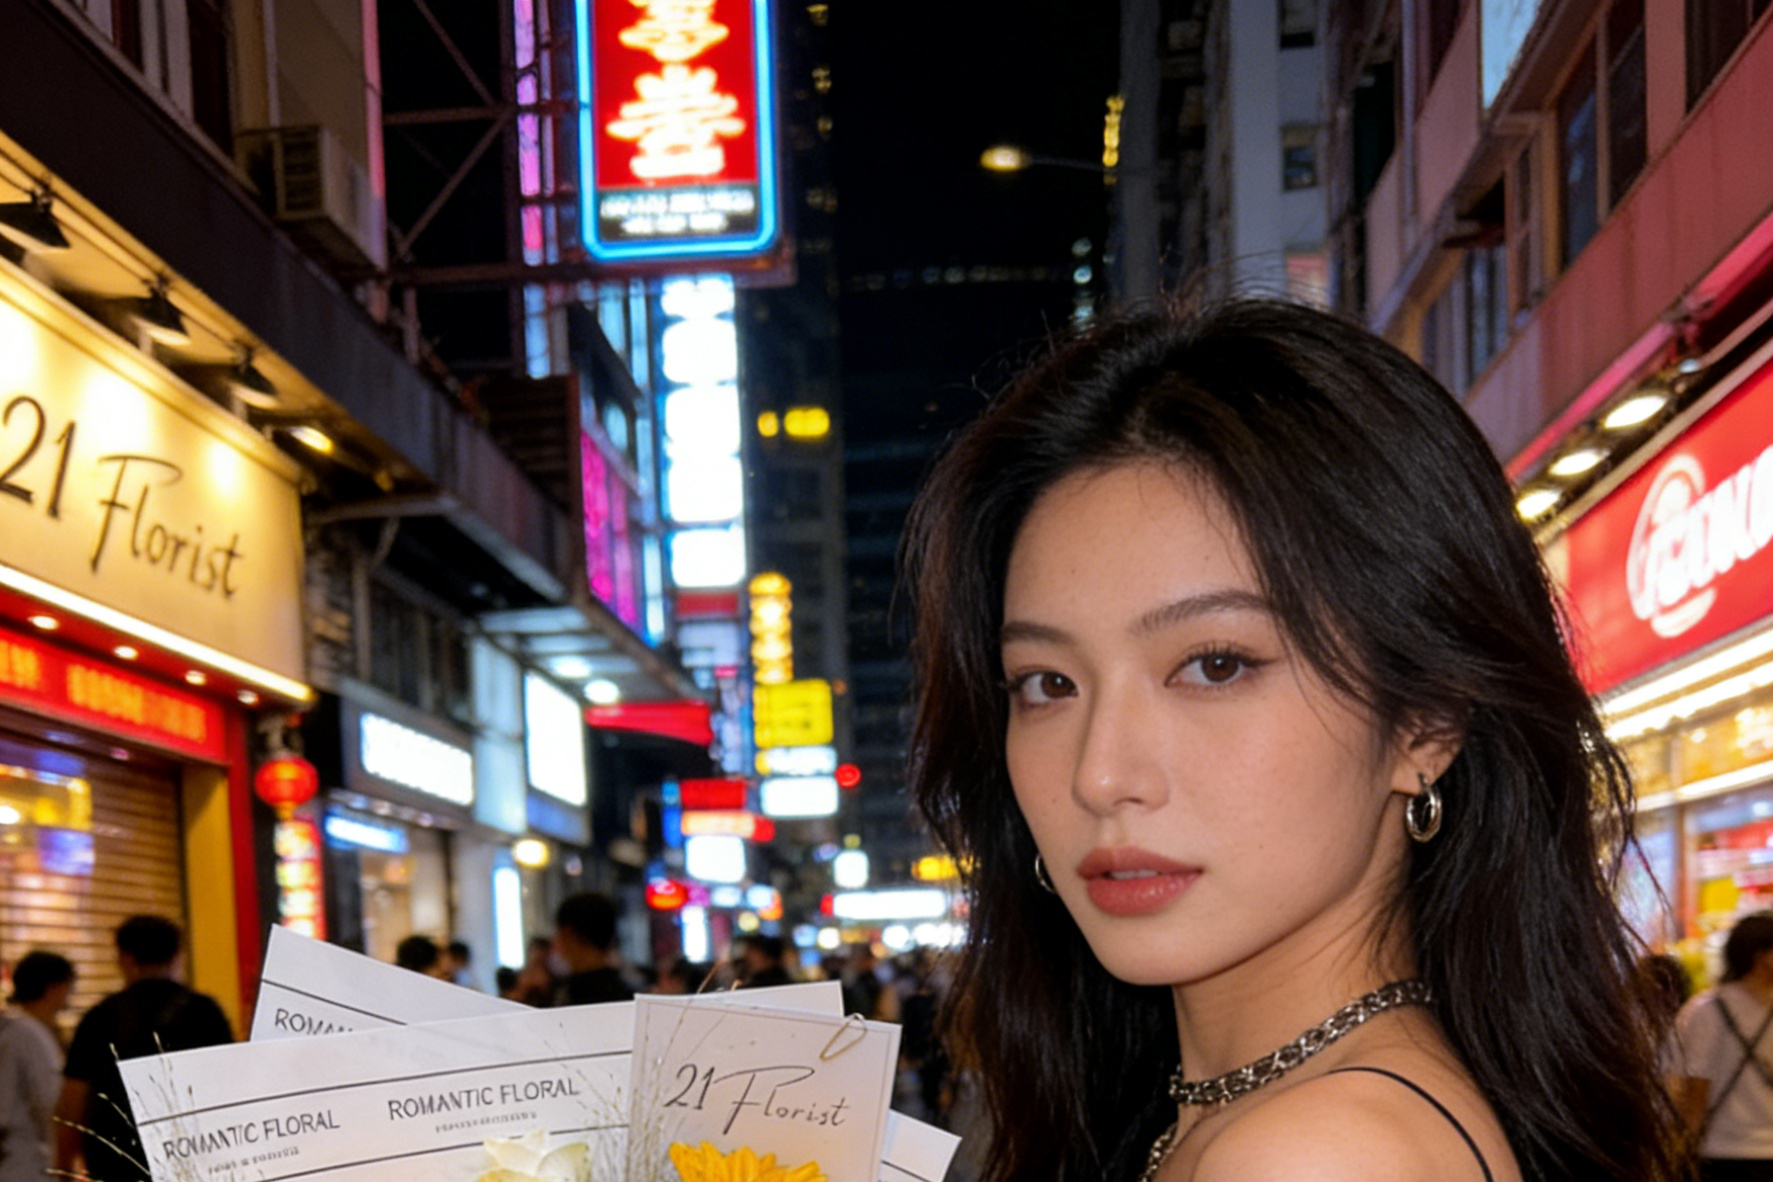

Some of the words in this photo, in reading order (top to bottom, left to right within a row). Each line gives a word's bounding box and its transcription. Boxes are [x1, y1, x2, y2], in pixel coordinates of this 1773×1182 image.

[0, 395, 76, 521] 21
[91, 454, 244, 599] Florist
[387, 1086, 494, 1121] ROMANTIC
[499, 1077, 581, 1105] FLORAL
[663, 1063, 716, 1111] 21
[712, 1065, 851, 1136] Florist
[162, 1122, 260, 1161] ROMANTIC
[262, 1109, 341, 1141] FLORAL
